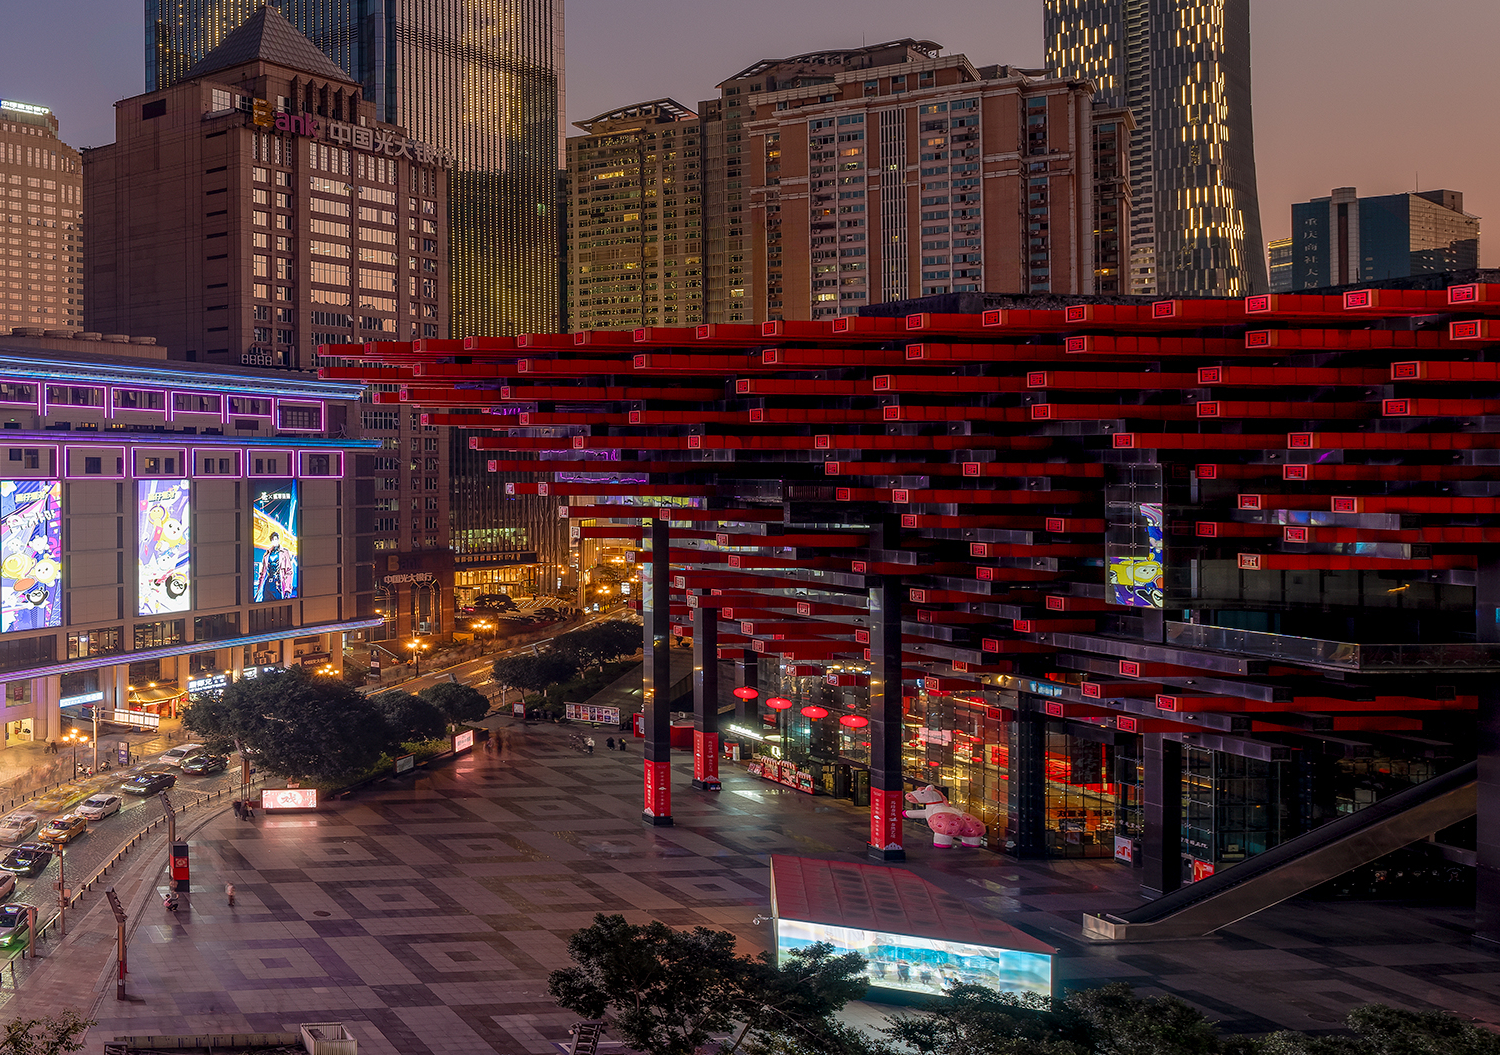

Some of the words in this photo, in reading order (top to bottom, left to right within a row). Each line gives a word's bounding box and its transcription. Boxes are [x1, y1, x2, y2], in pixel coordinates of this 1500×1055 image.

[329, 121, 454, 168] 中国光大银行
